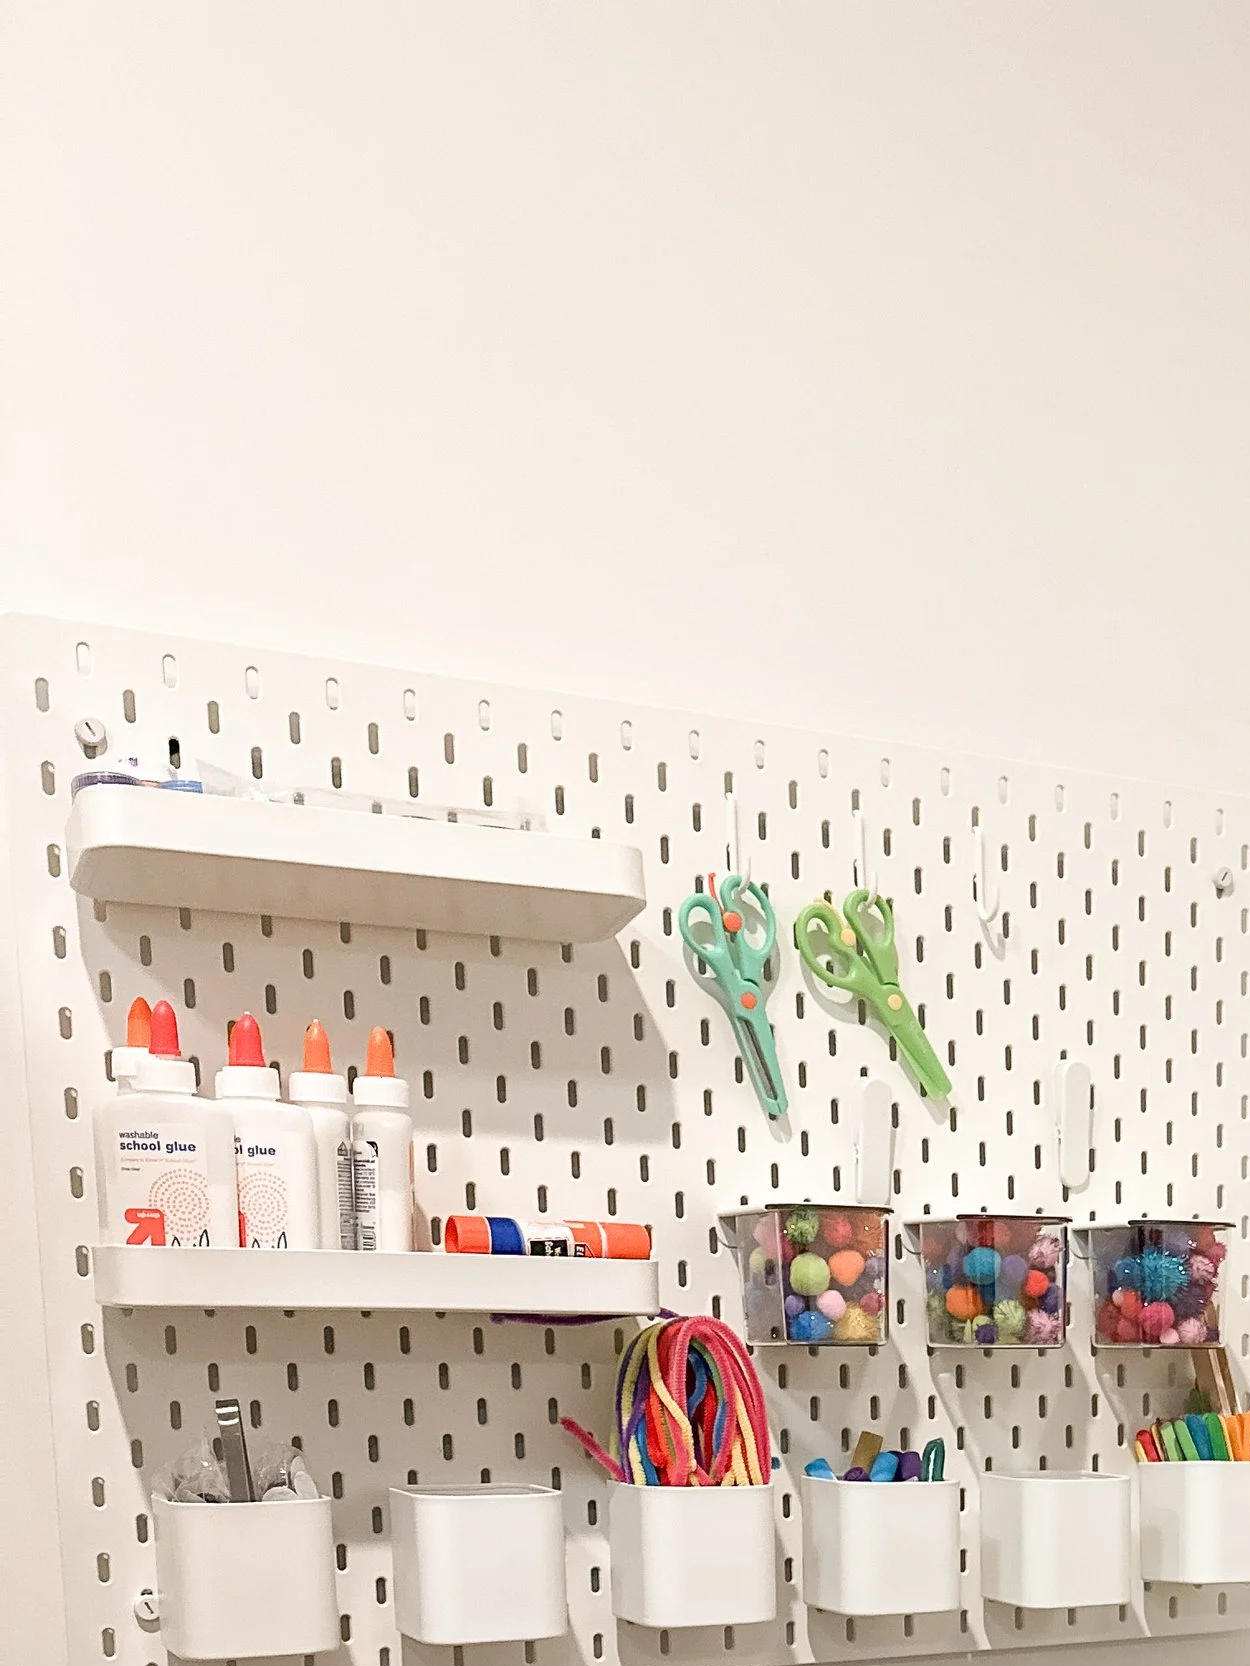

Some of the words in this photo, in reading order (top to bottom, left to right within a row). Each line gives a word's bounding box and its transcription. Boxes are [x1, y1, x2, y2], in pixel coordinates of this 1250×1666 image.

[119, 1131, 159, 1140] washable
[119, 1140, 161, 1152] school
[165, 1141, 197, 1154] glue
[247, 1145, 276, 1157] glue
